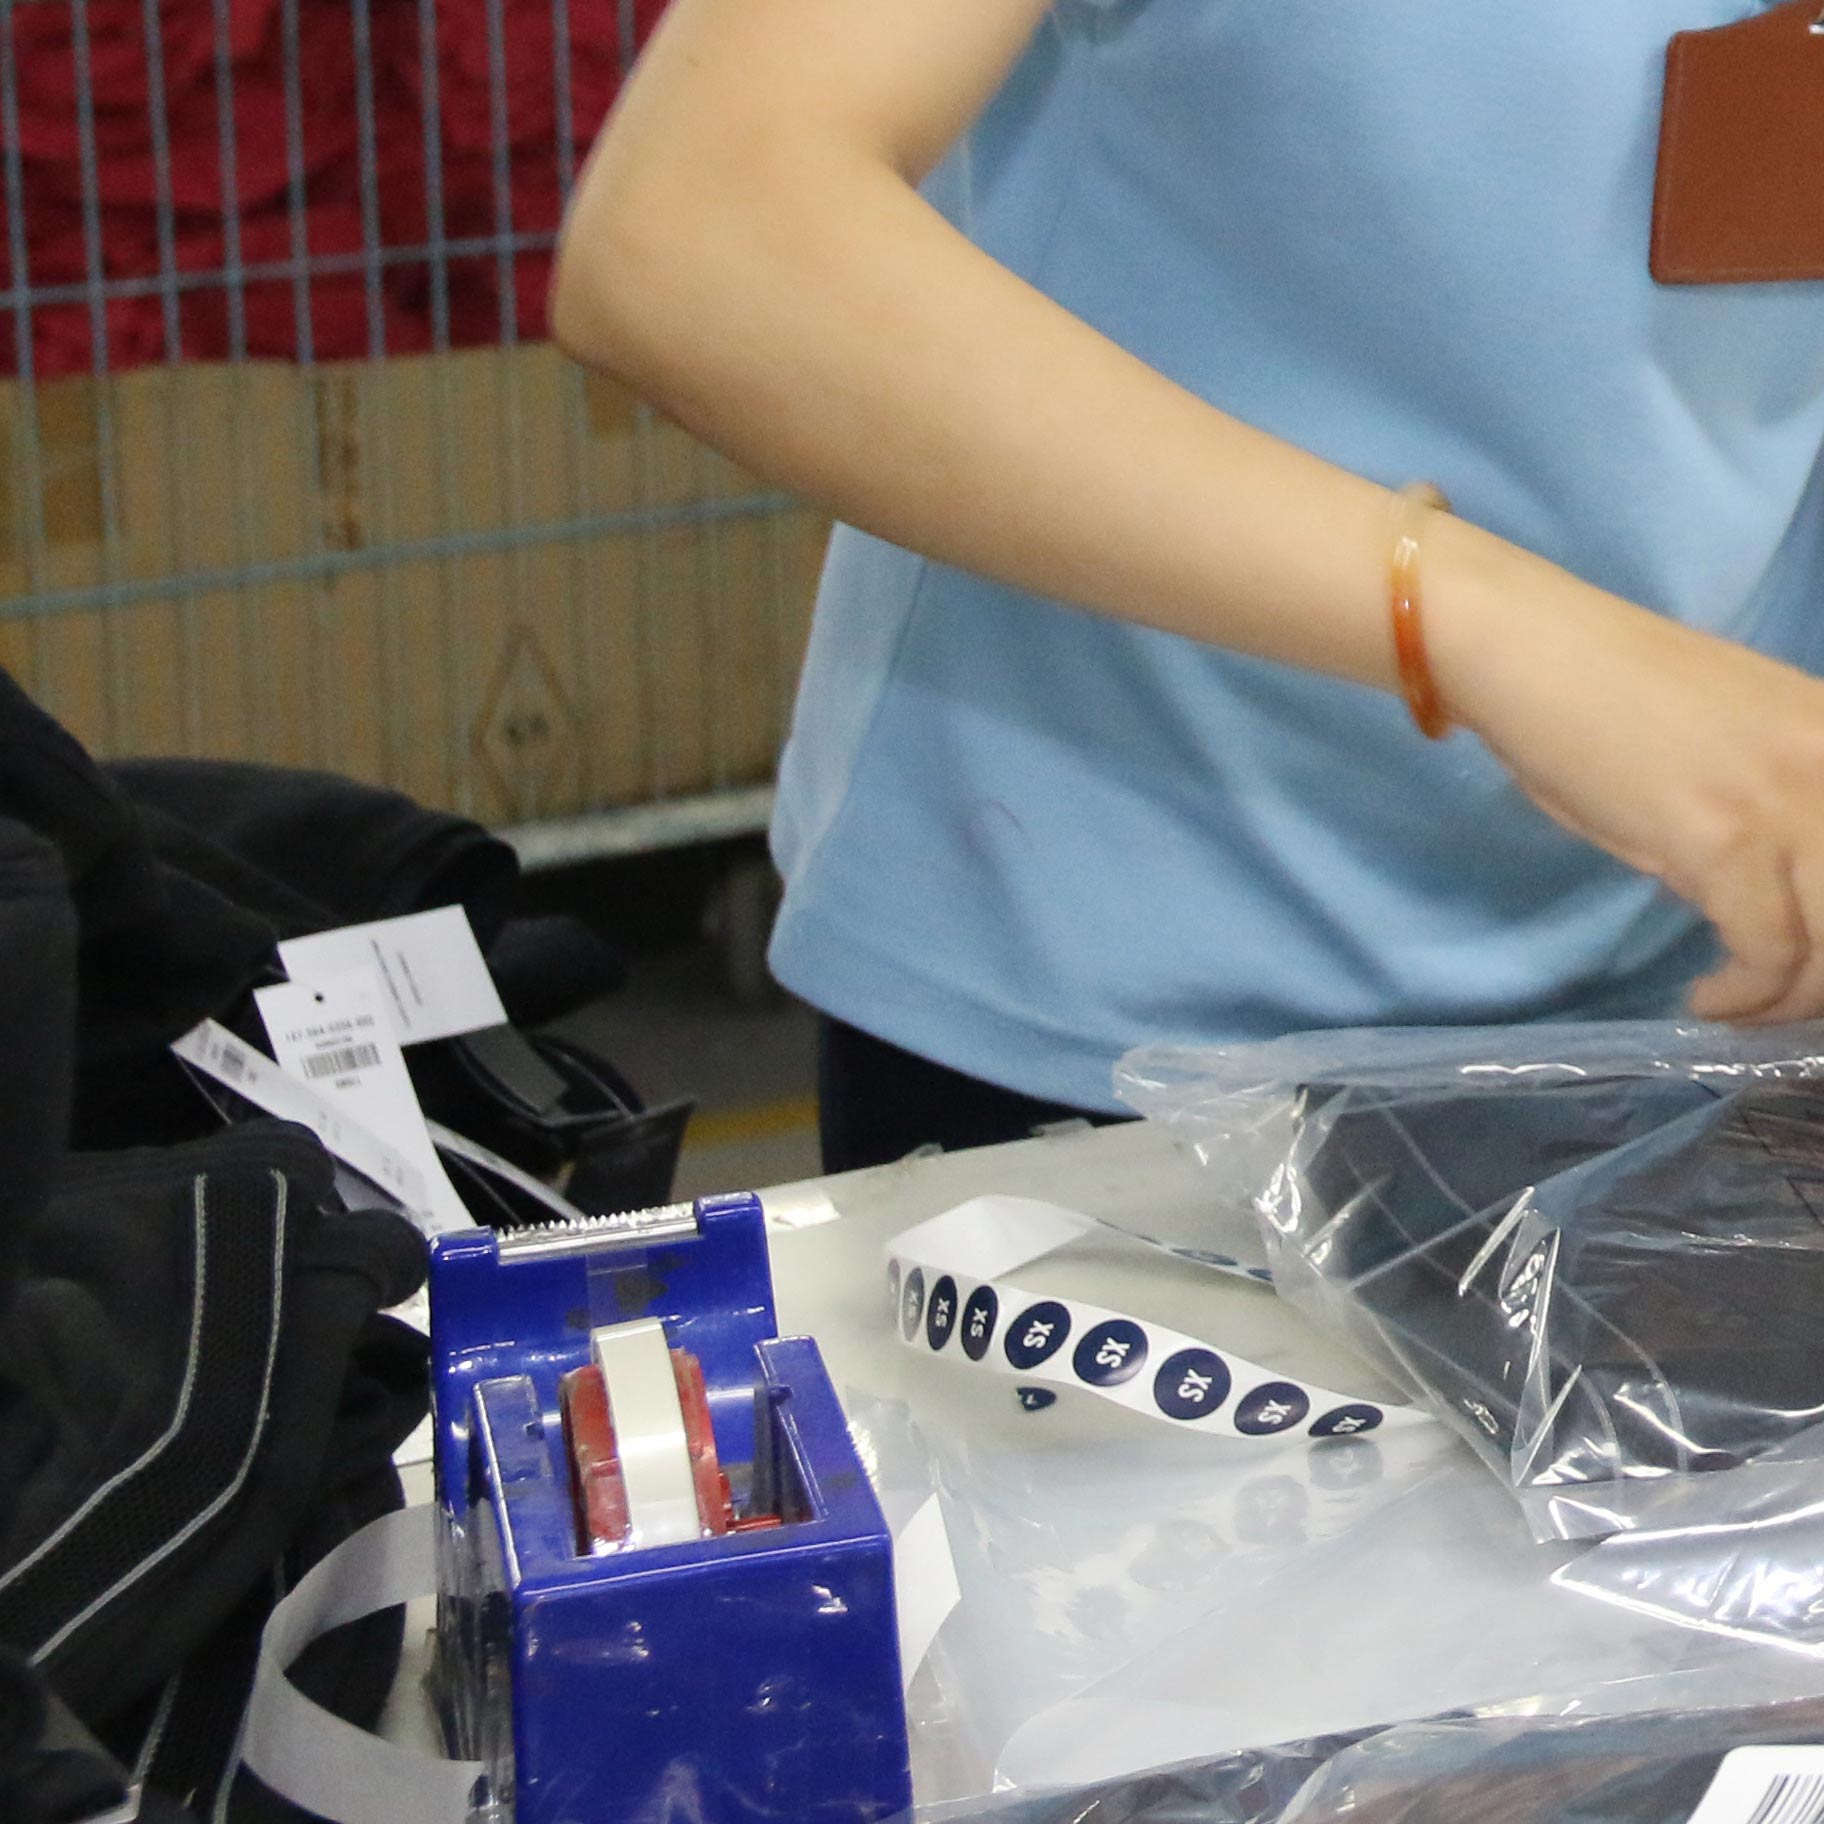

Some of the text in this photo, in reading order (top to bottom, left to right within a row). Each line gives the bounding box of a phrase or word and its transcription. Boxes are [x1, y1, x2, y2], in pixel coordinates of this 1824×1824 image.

[935, 1297, 950, 1328] XS
[970, 1307, 989, 1338] XS
[1022, 1319, 1055, 1349] XS
[1095, 1337, 1131, 1368] XS
[1178, 1368, 1213, 1402] XS
[1258, 1399, 1292, 1425] XS
[1332, 1416, 1366, 1433] XS
